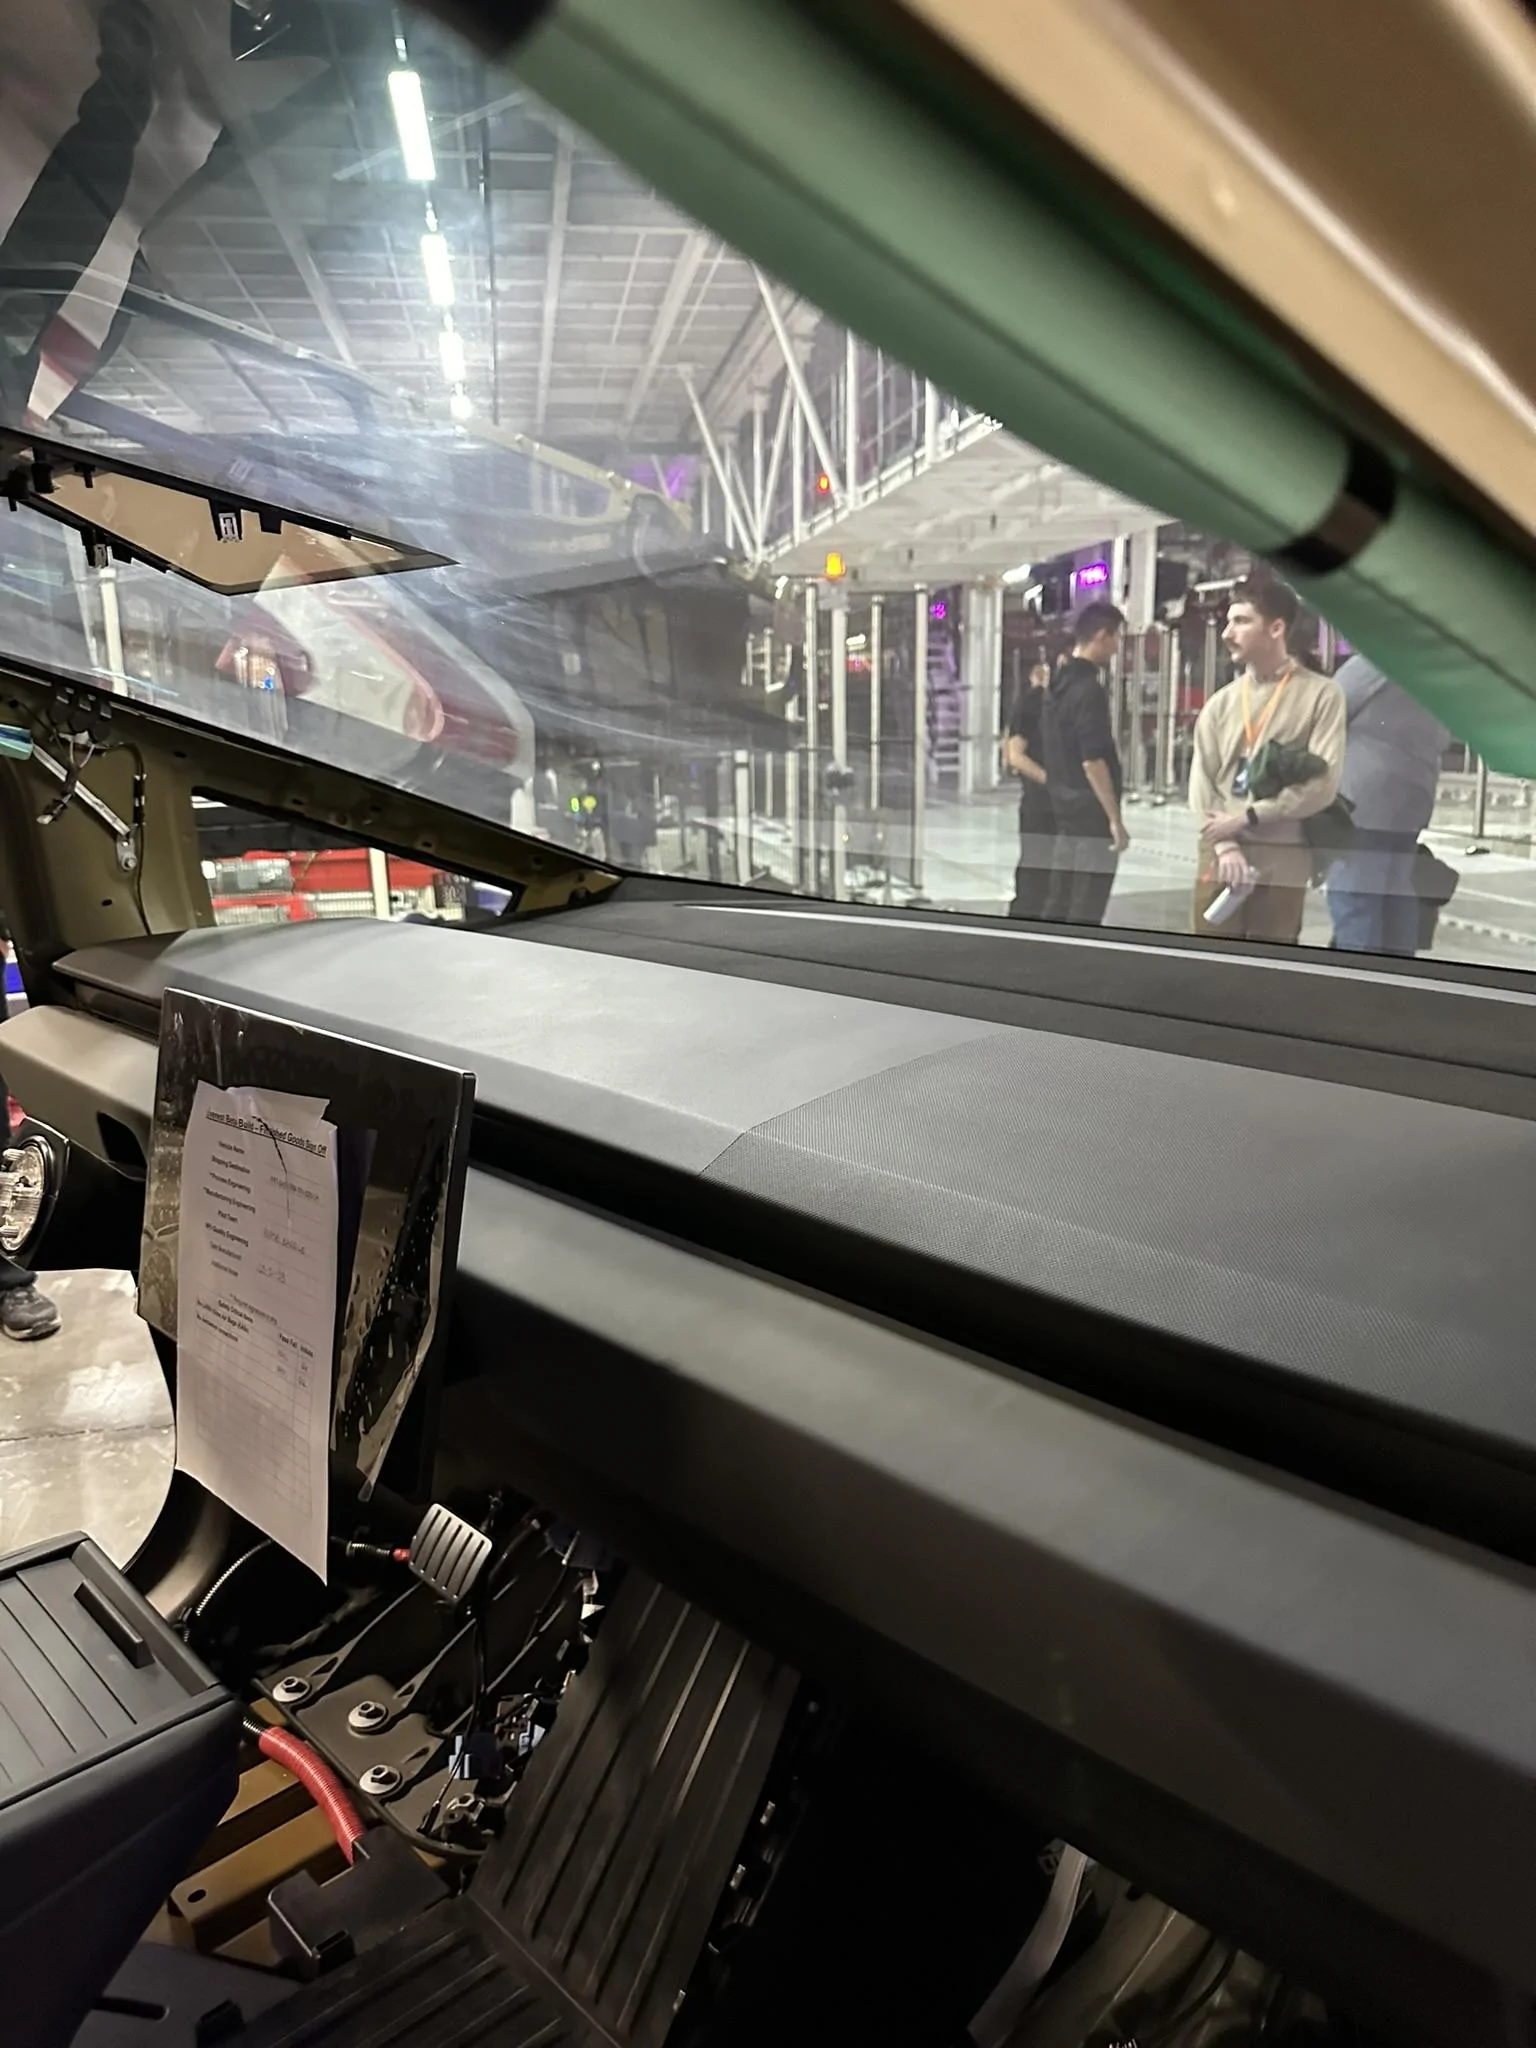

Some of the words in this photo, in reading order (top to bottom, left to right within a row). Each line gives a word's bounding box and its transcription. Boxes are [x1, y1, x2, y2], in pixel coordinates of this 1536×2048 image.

[238, 1118, 254, 1130] Build
[287, 1132, 305, 1147] Goods
[317, 1144, 328, 1155] Off
